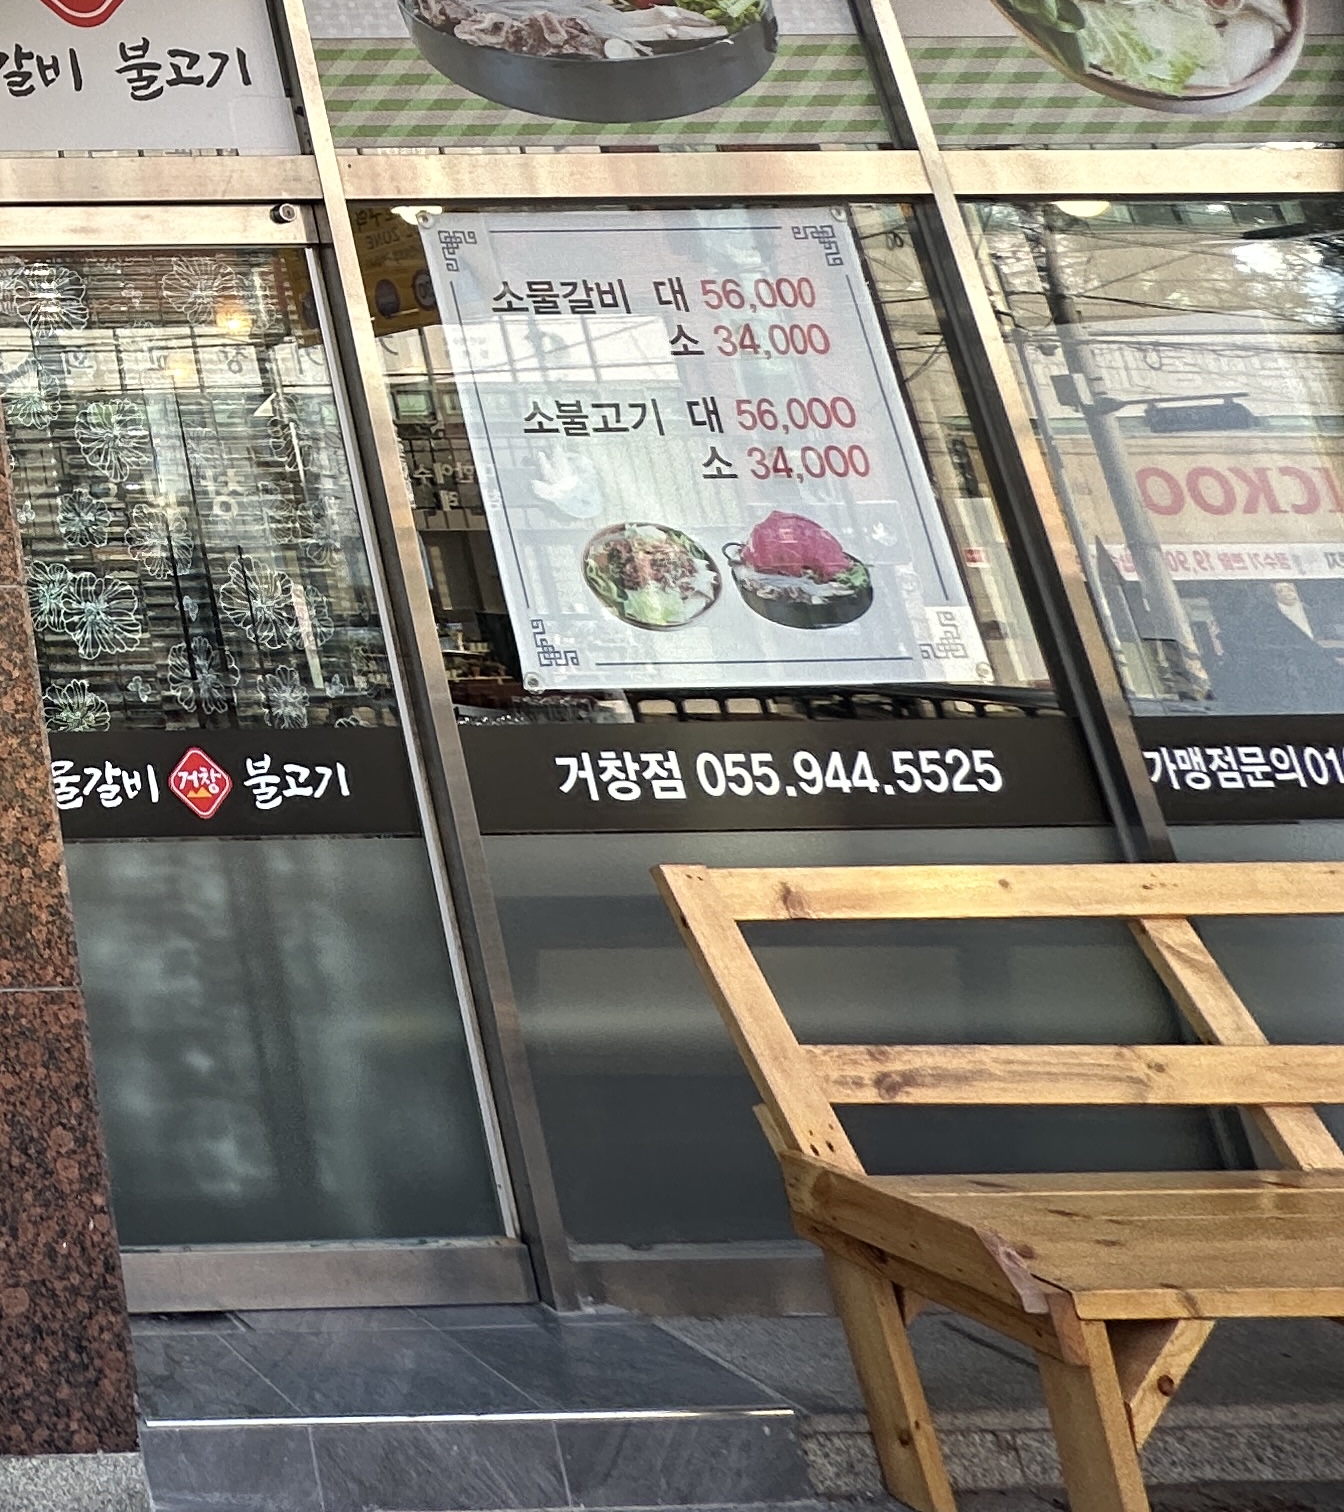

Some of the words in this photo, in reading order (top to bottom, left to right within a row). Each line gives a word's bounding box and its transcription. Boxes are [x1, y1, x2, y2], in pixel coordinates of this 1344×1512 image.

[115, 38, 252, 101] 불고기
[491, 278, 632, 316] 소물갈비
[657, 277, 691, 313] 대
[701, 276, 816, 316] 56,000
[669, 324, 705, 358] 소
[713, 322, 831, 358] 34,000
[523, 397, 666, 437] 소불고기
[690, 396, 725, 436] 대
[735, 395, 857, 434] 56,000
[701, 445, 738, 482] 소
[749, 444, 870, 481] 34,000
[52, 761, 160, 811] 물갈비
[178, 767, 222, 790] 거창
[243, 754, 350, 810] 불고기
[554, 750, 686, 802] 거창점
[697, 747, 1003, 799] 055.944.5525
[1303, 745, 1344, 786] 01
